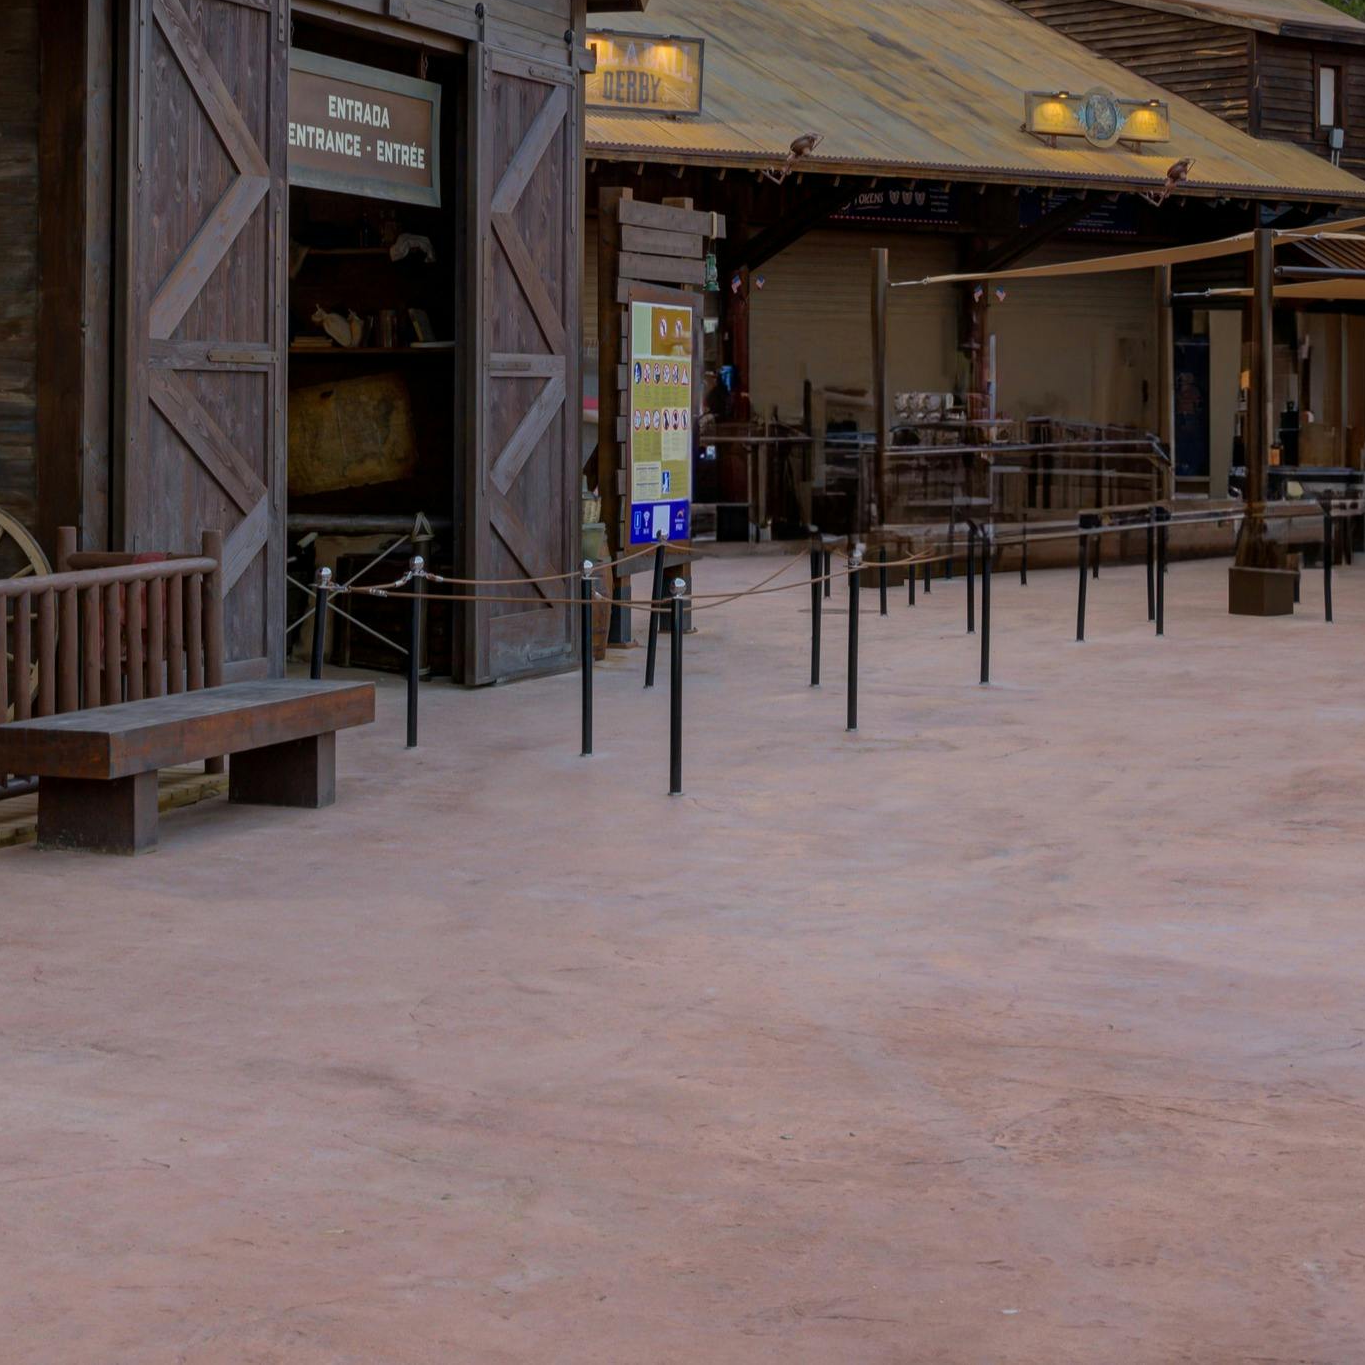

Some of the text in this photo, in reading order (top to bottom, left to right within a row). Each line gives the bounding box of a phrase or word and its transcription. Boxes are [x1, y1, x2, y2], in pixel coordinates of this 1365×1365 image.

[603, 70, 661, 103] DERBY
[328, 94, 390, 129] ENTRADA
[288, 122, 361, 157] ENTRANCE
[377, 139, 425, 169] ENTRÉE
